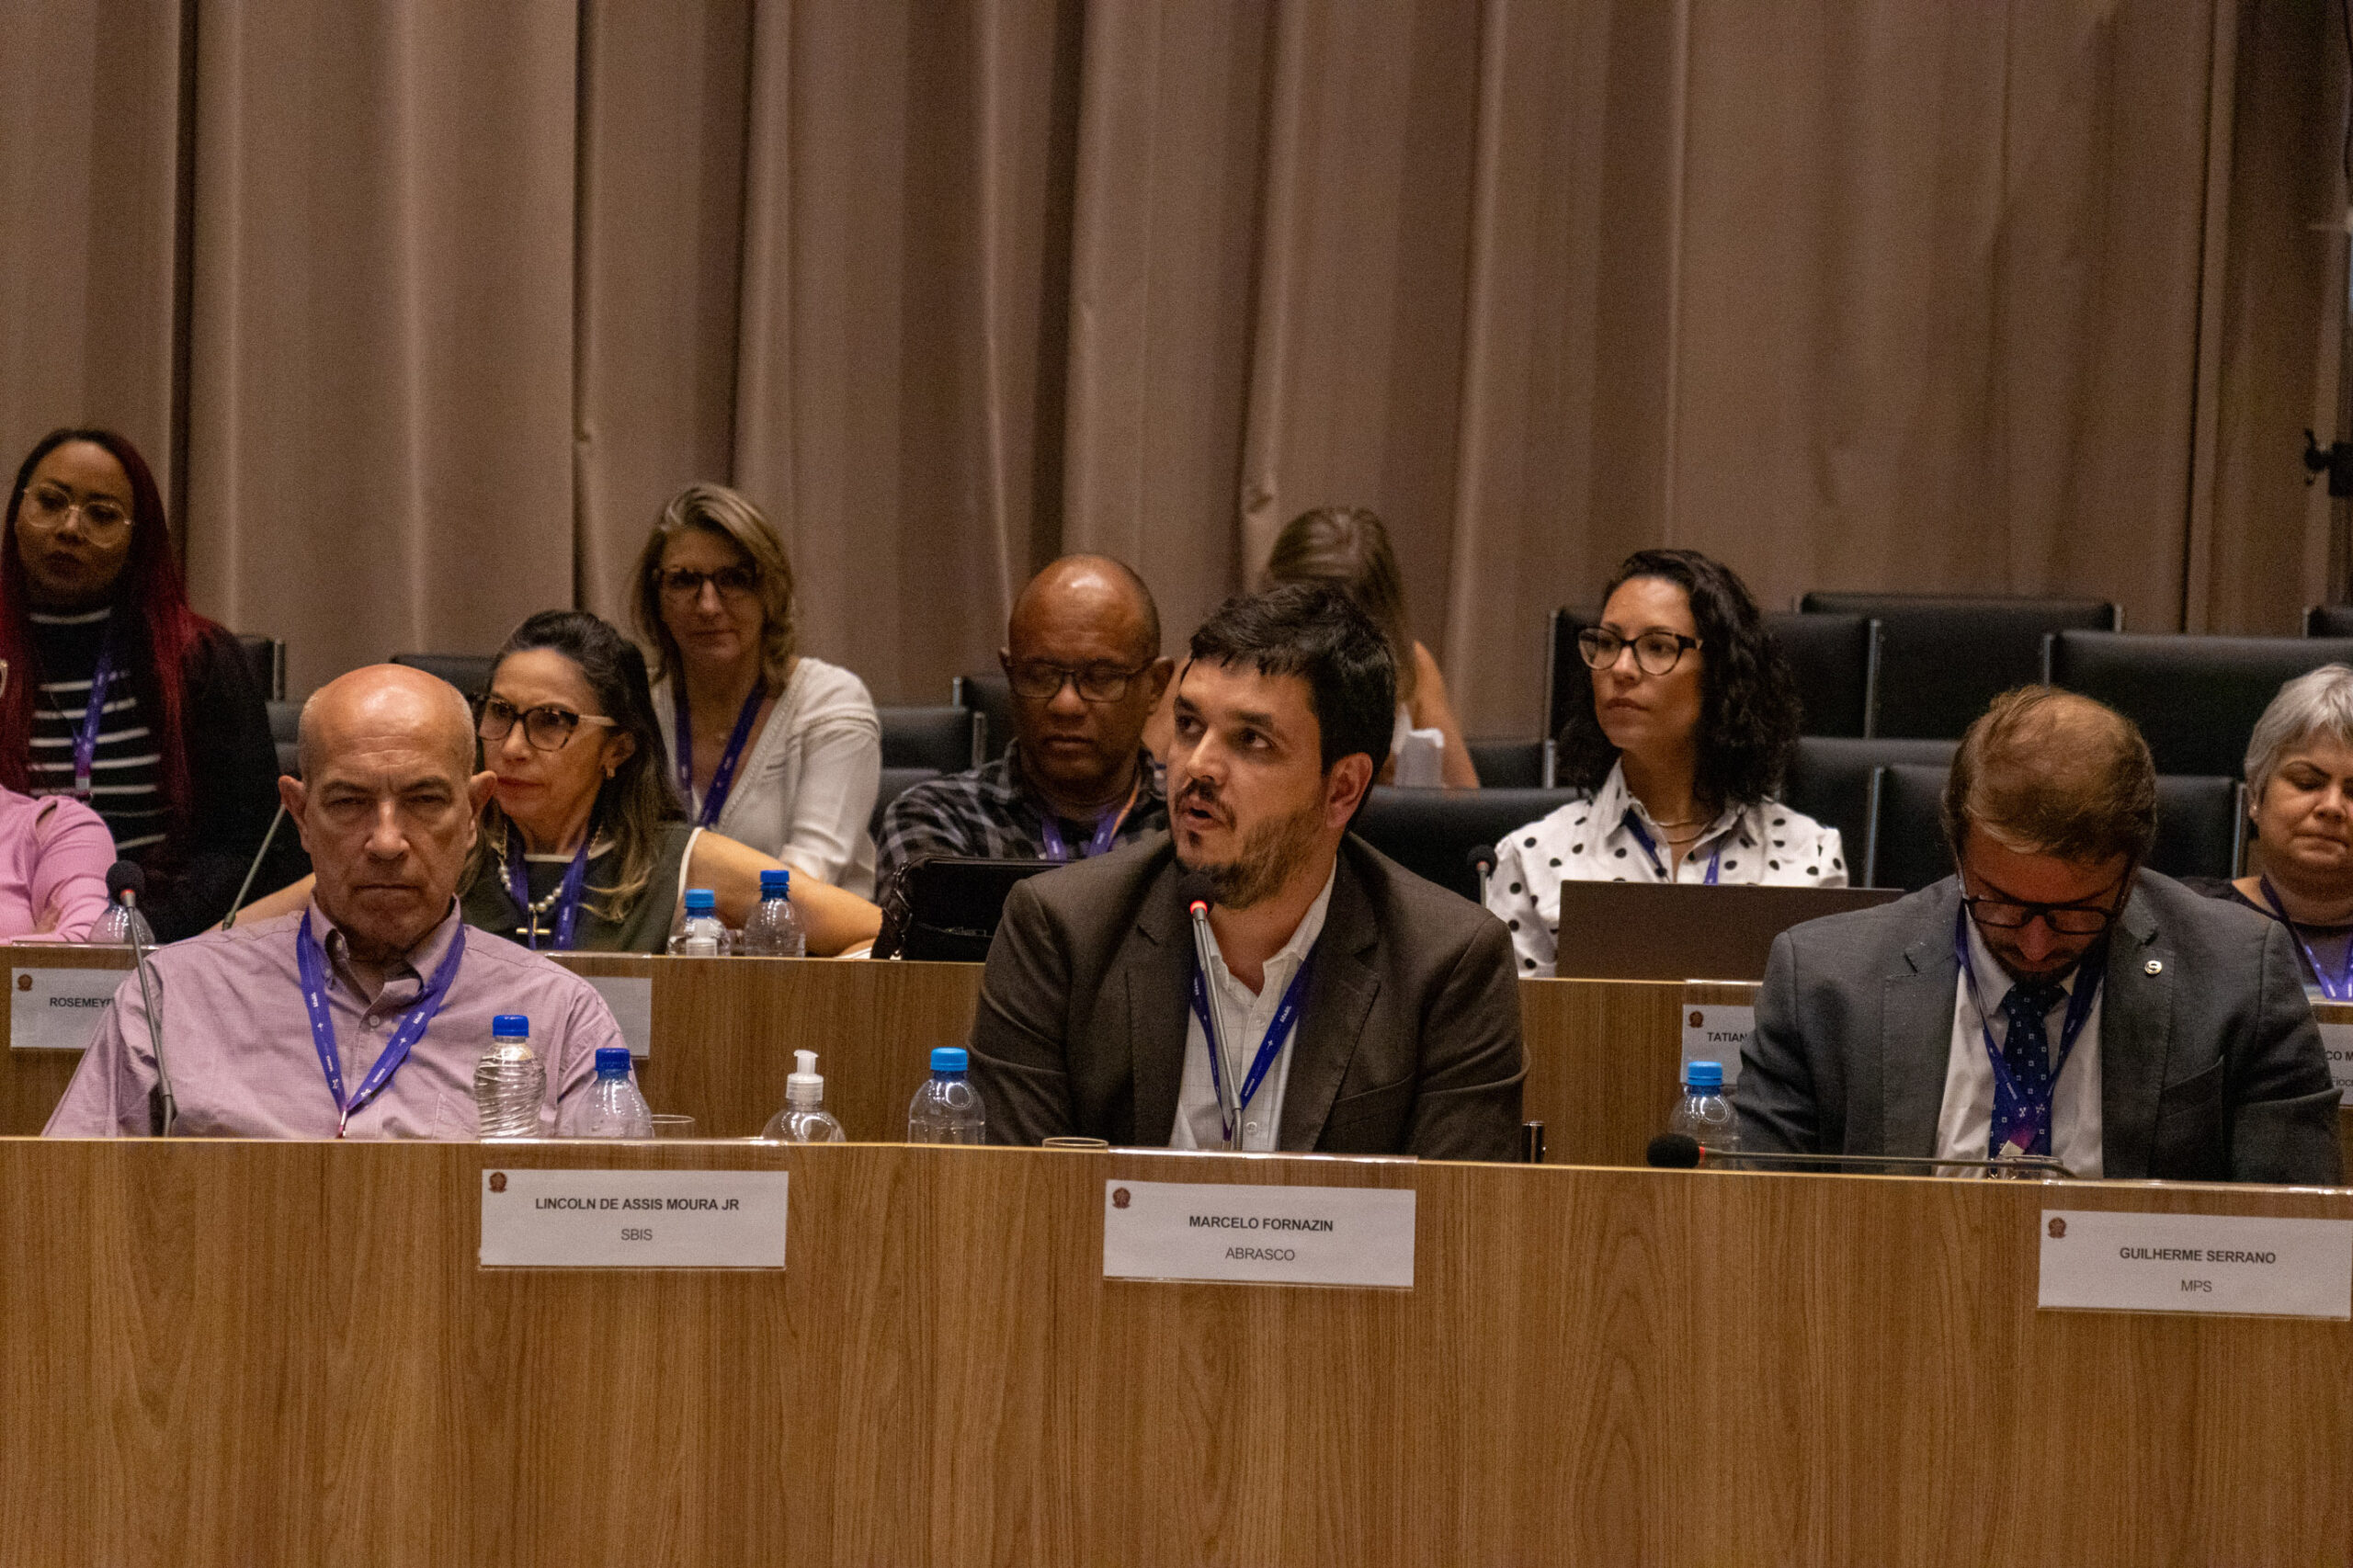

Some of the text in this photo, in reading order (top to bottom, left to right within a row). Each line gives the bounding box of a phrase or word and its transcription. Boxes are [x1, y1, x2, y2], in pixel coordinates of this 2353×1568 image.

[535, 1198, 740, 1210] LINCOLN DE ASSIS MOURA JR
[1188, 1215, 1334, 1232] MARCELO FORNAZIN
[620, 1228, 653, 1241] SBIS
[1224, 1247, 1295, 1261] ABRASCO
[2120, 1247, 2277, 1264] GUILHERME SERRANO
[2180, 1279, 2212, 1293] MPS
